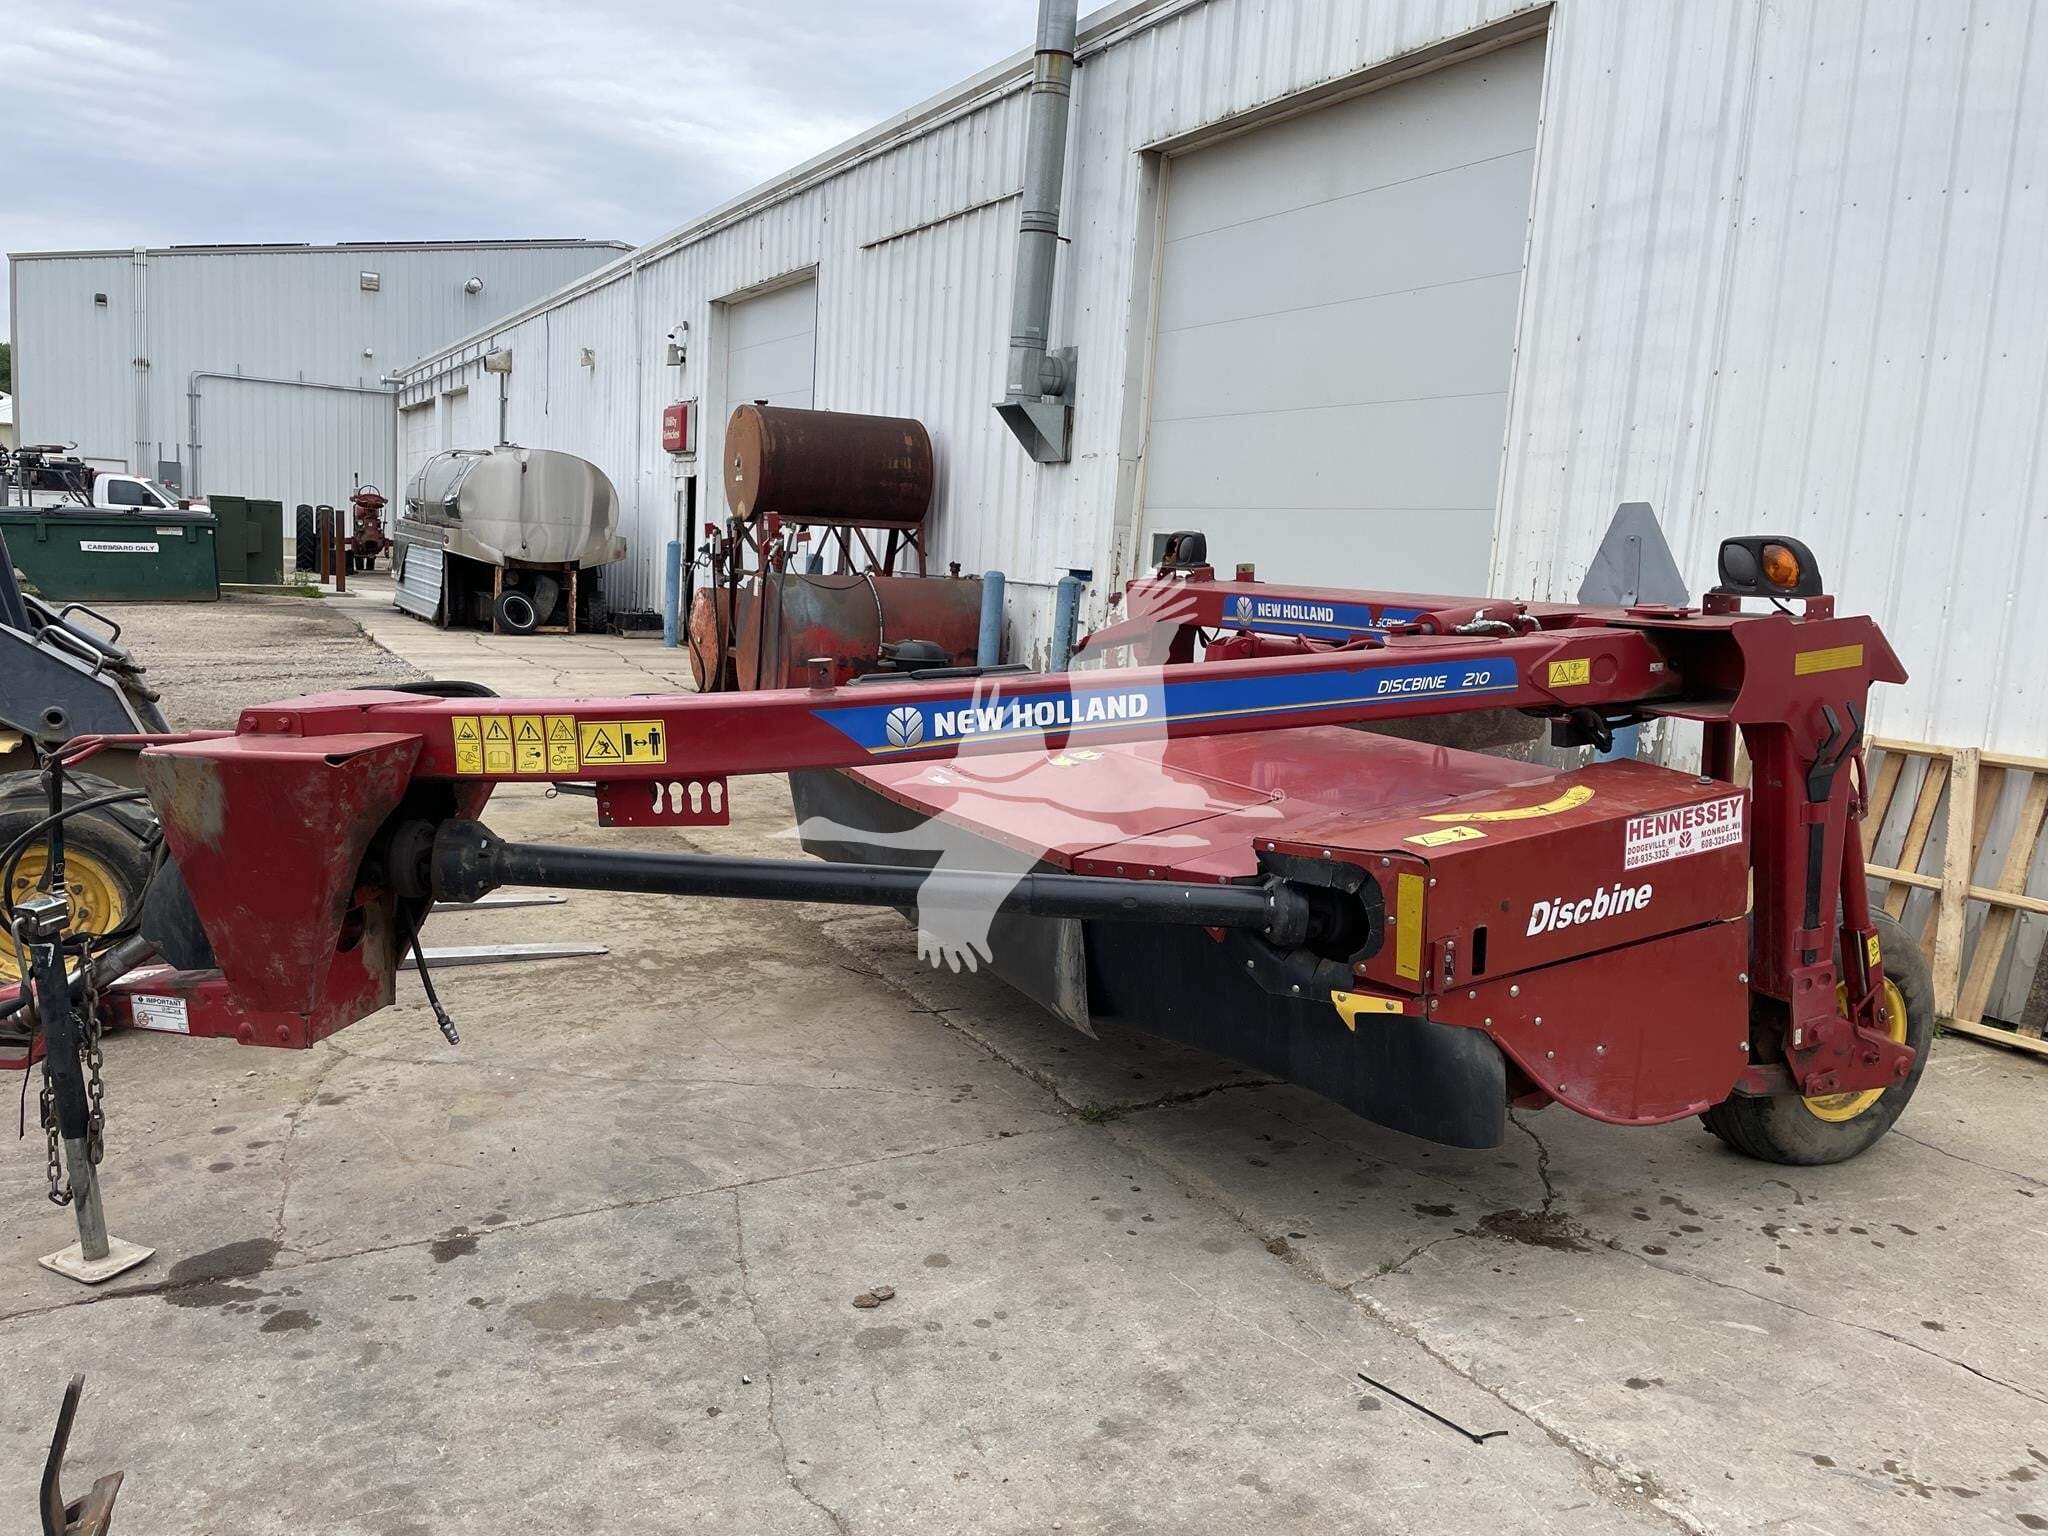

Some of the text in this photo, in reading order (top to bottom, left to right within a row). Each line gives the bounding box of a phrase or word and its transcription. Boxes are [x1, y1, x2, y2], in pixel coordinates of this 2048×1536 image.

[1257, 603, 1334, 622] NEW HOLLAND
[1377, 671, 1491, 694] DISCBINE 210
[933, 693, 1149, 737] NEW HOLLAND
[1629, 798, 1742, 842] HENNESSEY
[1626, 848, 1670, 866] 608-935-3326
[1526, 883, 1653, 937] Discbine
[146, 997, 181, 1006] IMPORTANT
